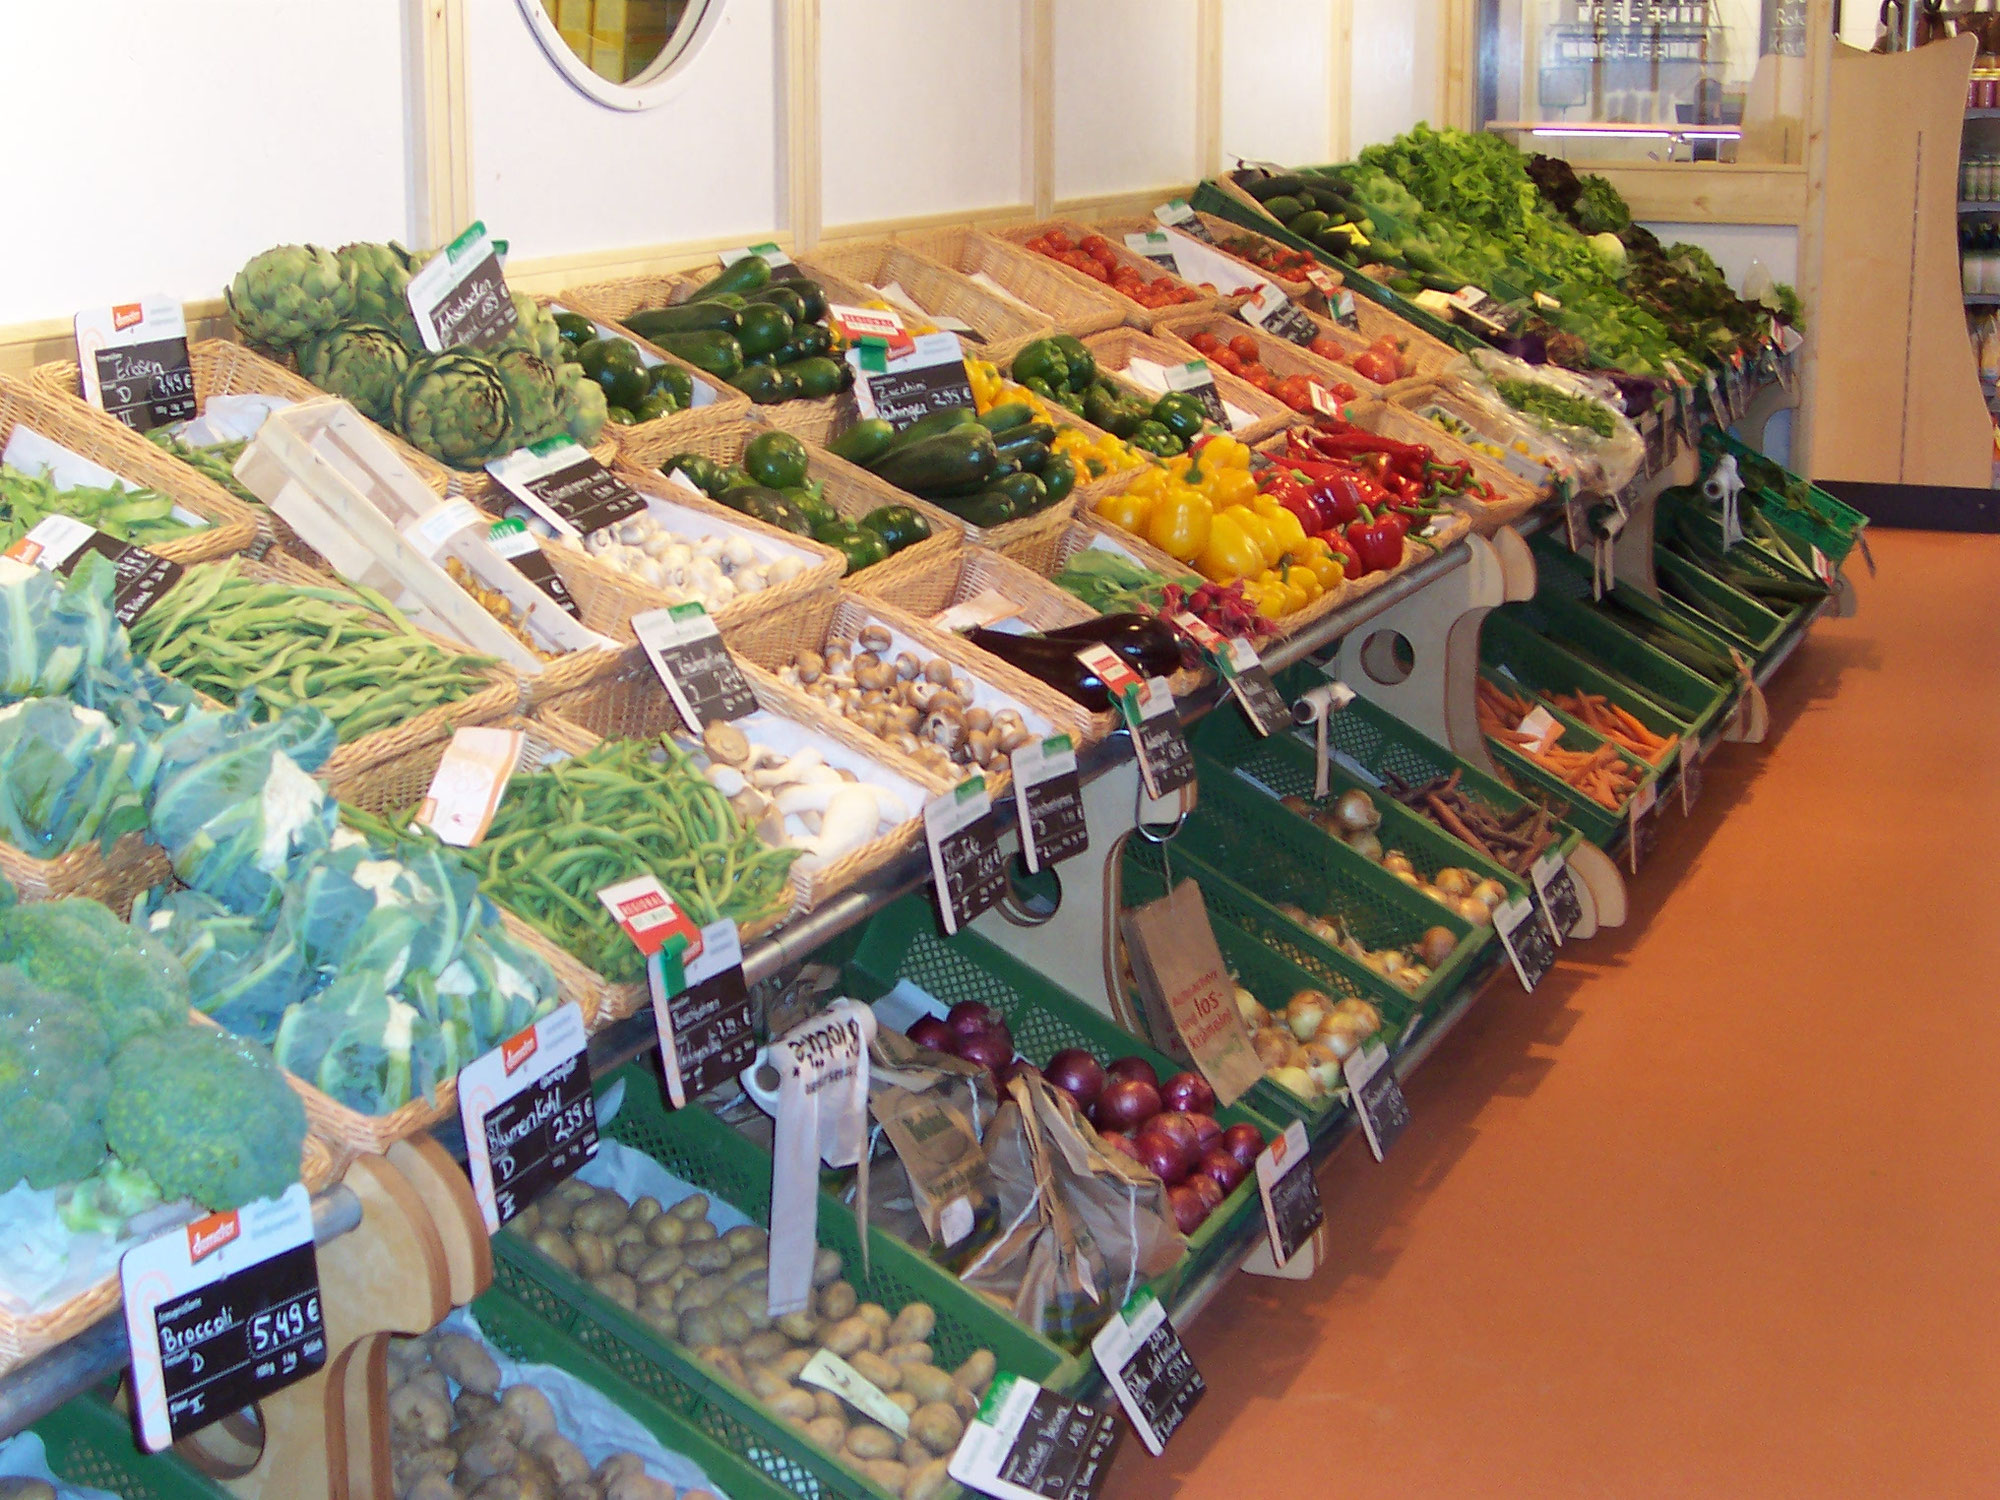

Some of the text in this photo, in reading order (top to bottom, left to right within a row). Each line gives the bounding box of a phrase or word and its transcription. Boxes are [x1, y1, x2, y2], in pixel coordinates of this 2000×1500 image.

[505, 1037, 535, 1070] demeter
[499, 1156, 516, 1181] D
[192, 1220, 235, 1255] demeter
[160, 1304, 234, 1351] Broccoli
[189, 1353, 205, 1374] D
[253, 1303, 304, 1351] 5,49
[306, 1297, 321, 1324] €
